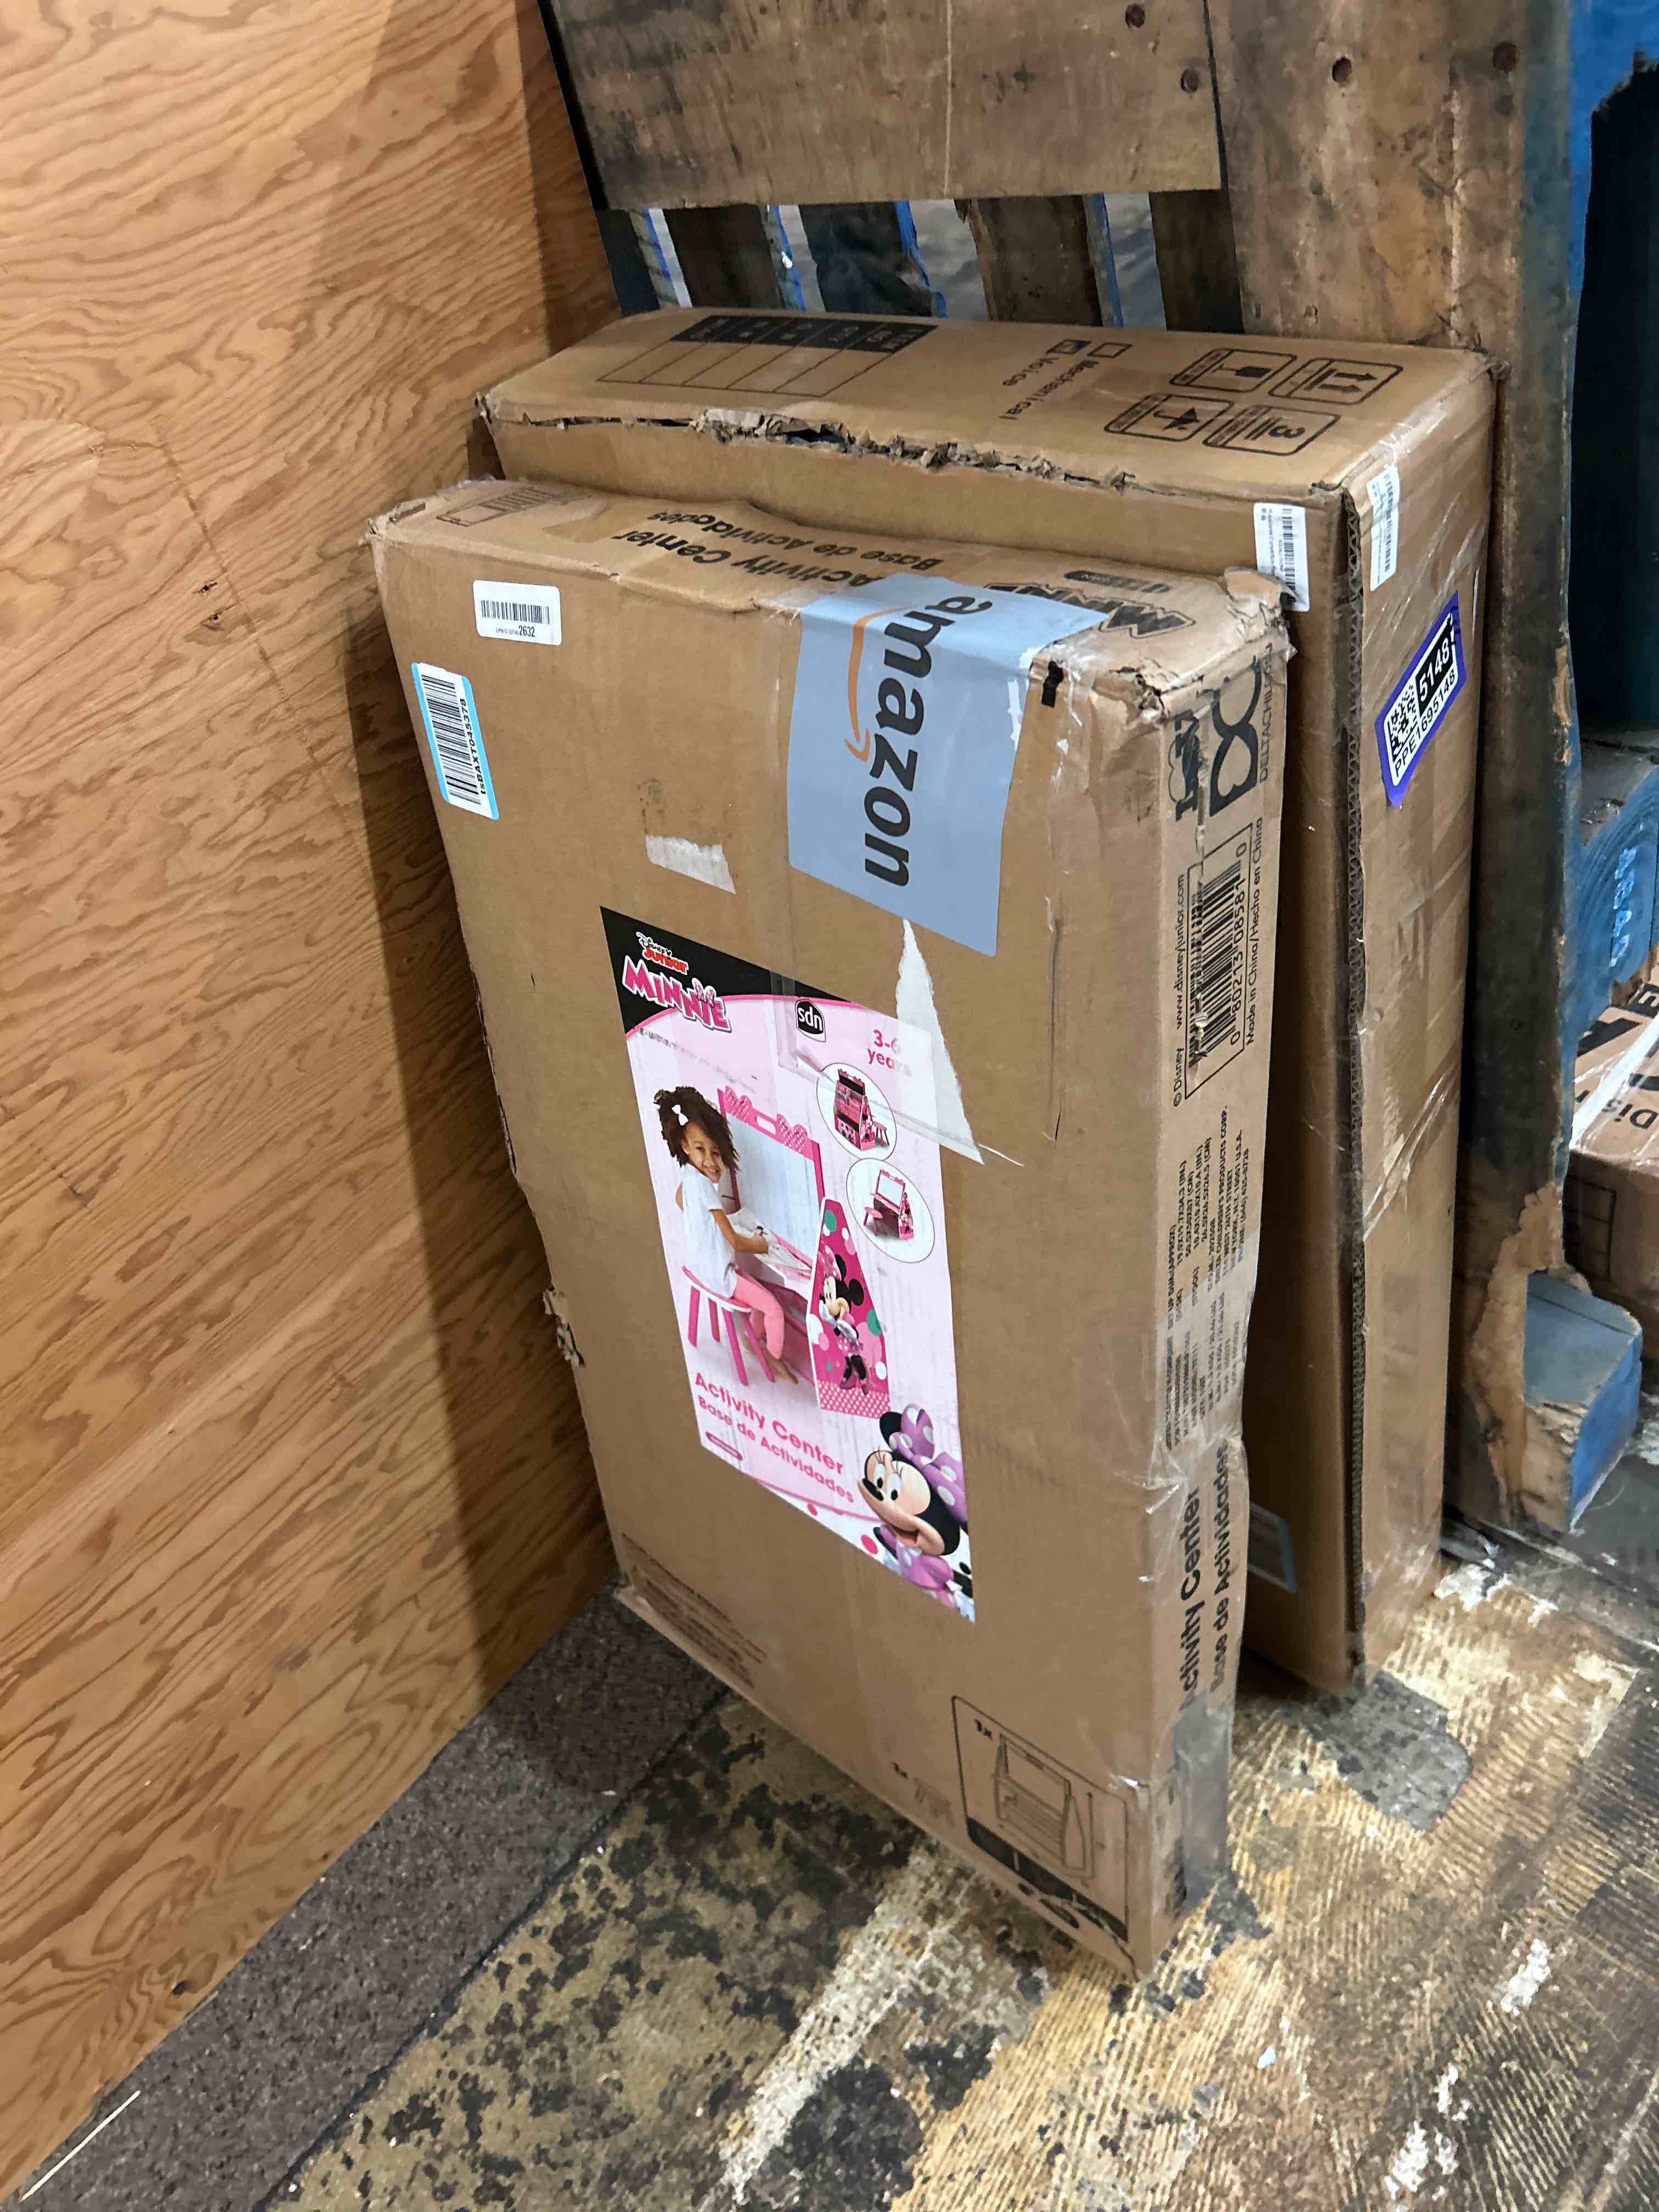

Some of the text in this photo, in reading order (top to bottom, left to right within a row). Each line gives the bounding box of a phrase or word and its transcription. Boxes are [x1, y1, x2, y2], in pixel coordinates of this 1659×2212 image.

[612, 531, 884, 587] Activity Center
[647, 511, 944, 571] Base de Actividades
[1419, 637, 1450, 702] 5148
[864, 596, 992, 887] amazon
[1394, 669, 1455, 777] PPE1695148
[1174, 874, 1186, 1030] www.disneyjunior.com
[1231, 842, 1246, 1046] 0 80213 08581 0
[1246, 817, 1263, 1045] Made in China/Hecho en China
[798, 1006, 823, 1031] sdn
[867, 1047, 913, 1076] yea
[1173, 1048, 1184, 1092] Disney
[695, 1372, 765, 1429] Activity
[772, 1421, 843, 1475] Center
[698, 1395, 732, 1425] Base
[737, 1423, 756, 1440] de
[761, 1436, 854, 1502] Actividades
[1214, 1438, 1229, 1595] Actividades
[1180, 1486, 1205, 1707] ctivity Center
[1214, 1598, 1229, 1631] de
